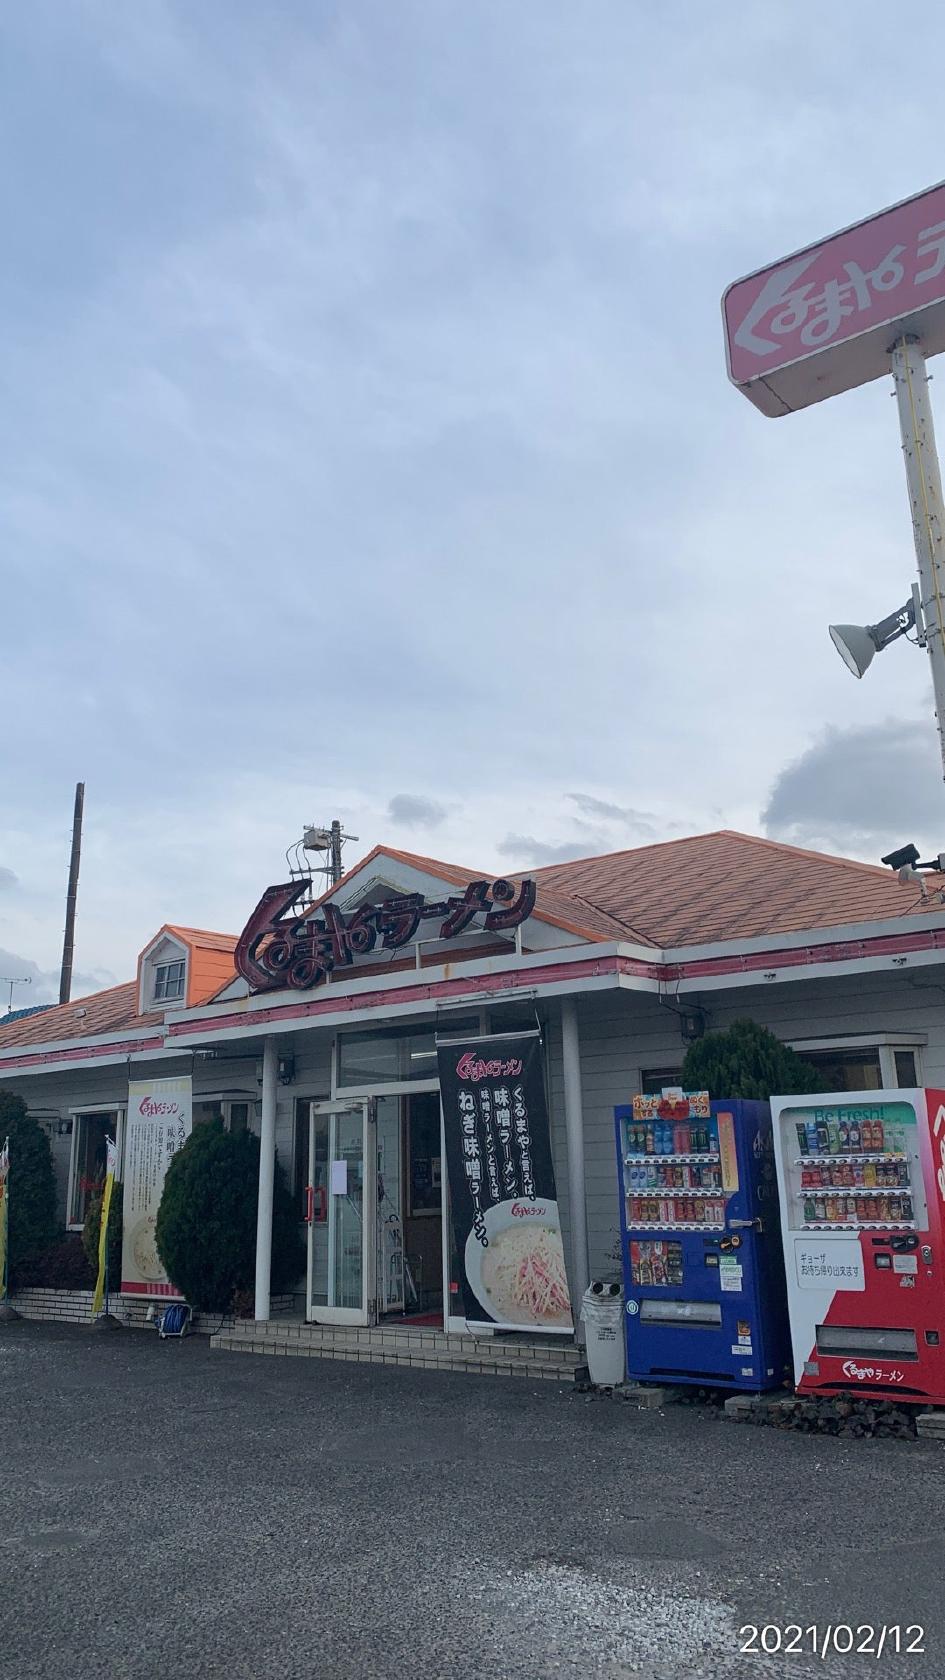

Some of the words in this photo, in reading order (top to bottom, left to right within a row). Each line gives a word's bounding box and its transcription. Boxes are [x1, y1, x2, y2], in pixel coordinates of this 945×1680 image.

[234, 879, 537, 990] くるまやラーメン
[456, 1053, 522, 1081] くるまやラーメン
[815, 1109, 834, 1122] Be
[838, 1106, 885, 1121] Fresh!
[458, 1089, 489, 1248] ねぎ味噌ラーメン。
[801, 1253, 826, 1264] ギョーザ
[801, 1265, 859, 1277] お持ち帰り出来ます
